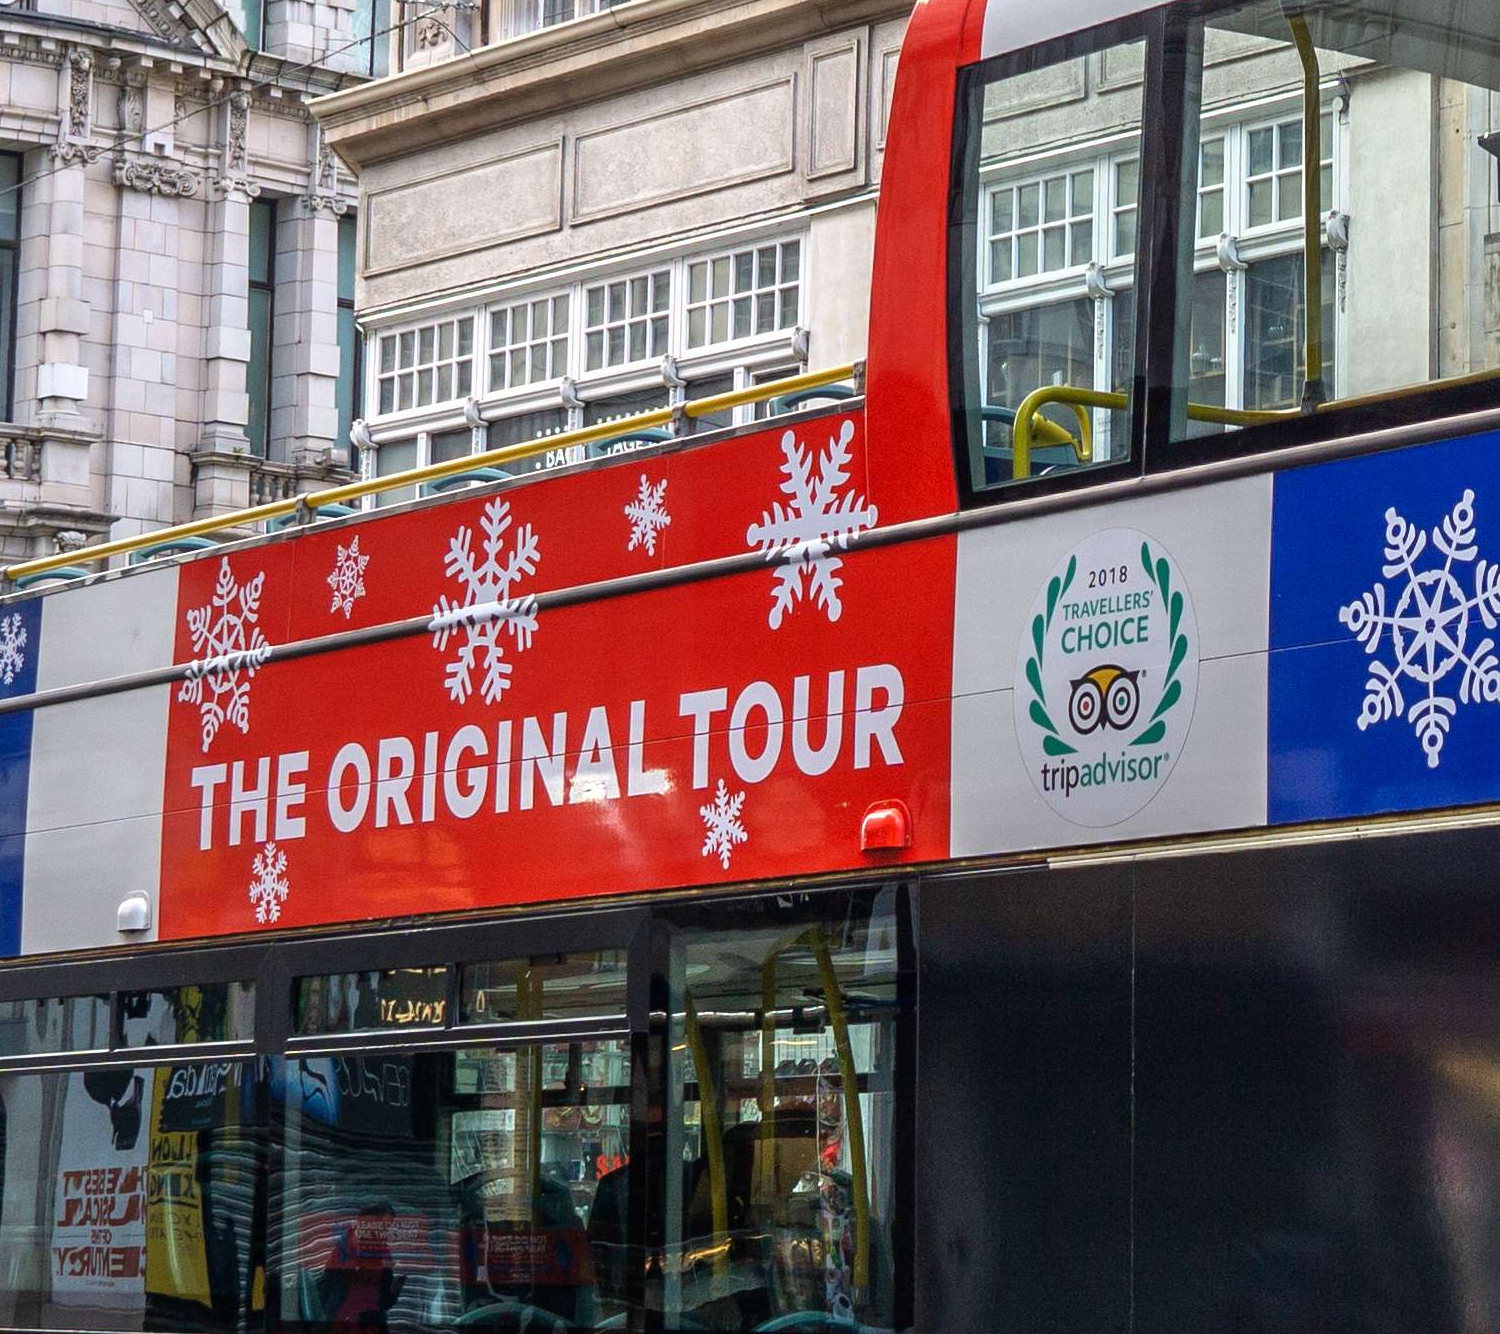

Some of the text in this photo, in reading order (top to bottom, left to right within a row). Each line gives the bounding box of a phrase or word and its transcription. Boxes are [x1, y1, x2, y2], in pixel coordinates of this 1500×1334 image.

[1088, 565, 1128, 589] 2018
[1060, 615, 1150, 655] CHOICE
[190, 663, 905, 851] THE ORIGINAL TOUR
[1040, 751, 1163, 798] tripadvisor
